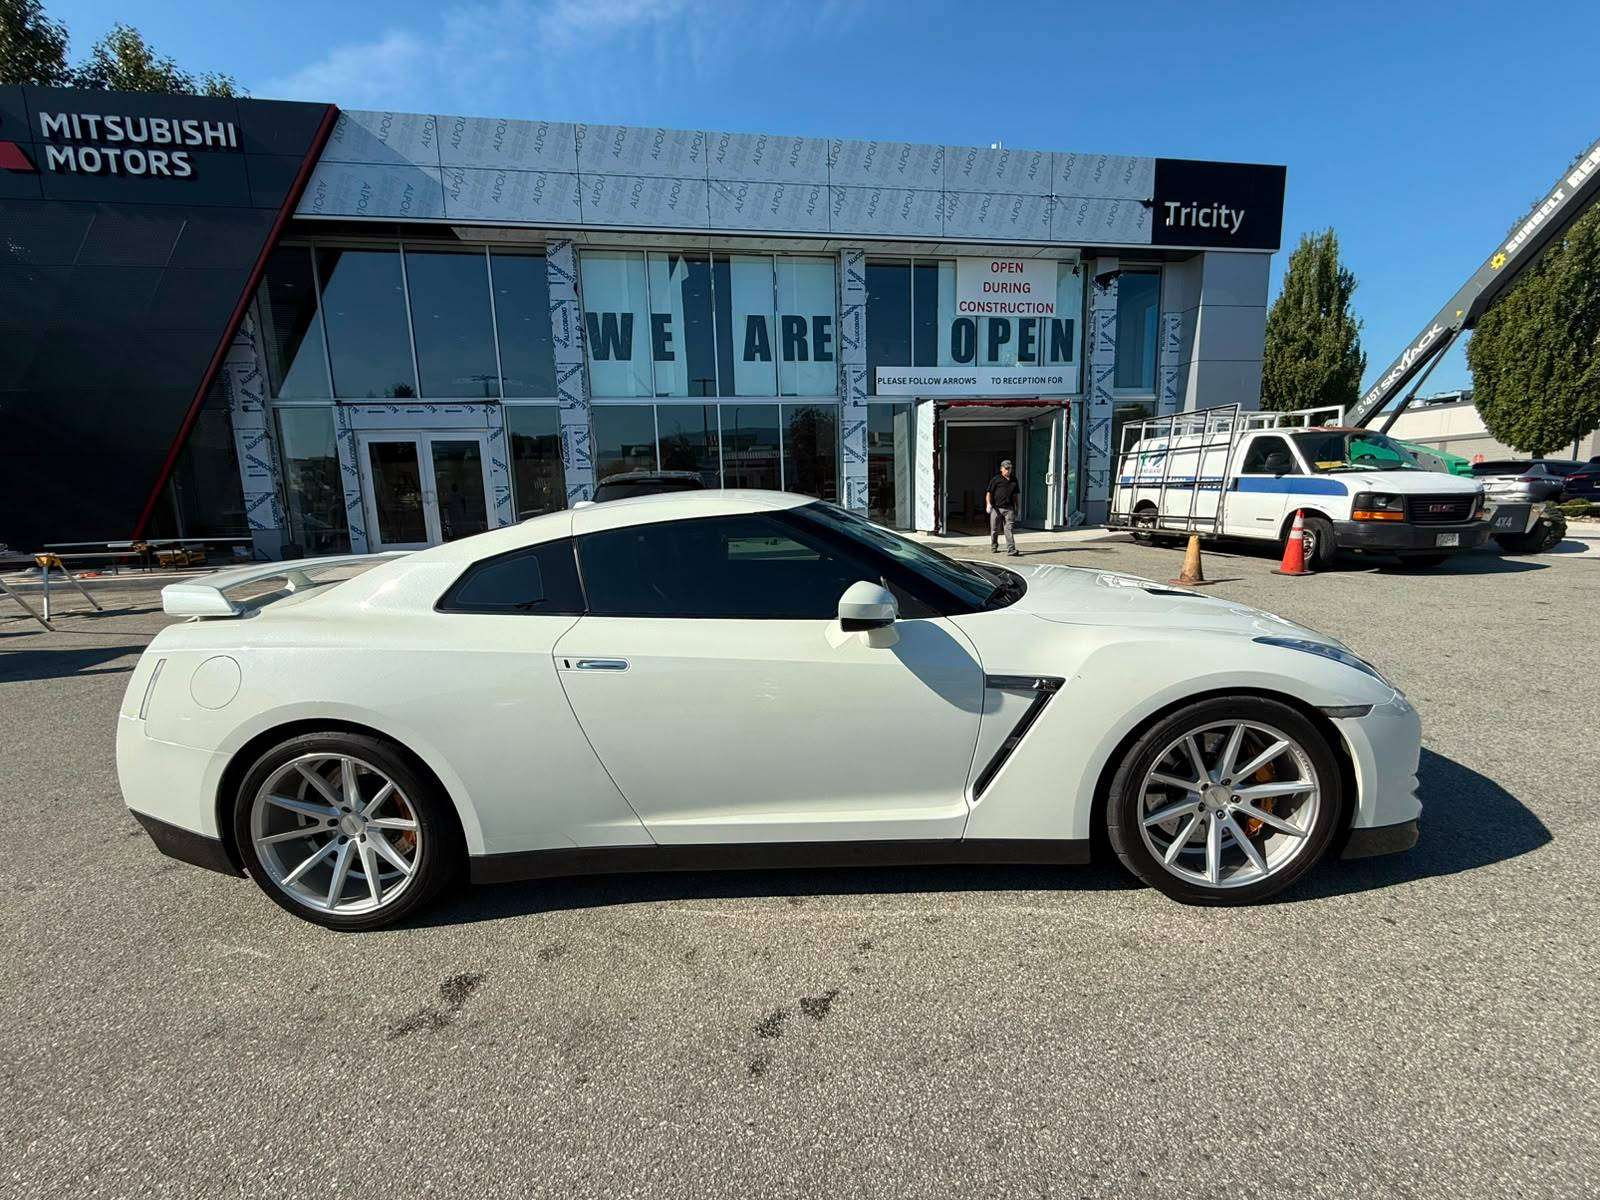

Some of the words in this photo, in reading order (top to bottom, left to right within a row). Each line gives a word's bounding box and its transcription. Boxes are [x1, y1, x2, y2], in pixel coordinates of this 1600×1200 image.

[39, 112, 237, 148] MITSUBISHI
[45, 144, 192, 177] MOTORS
[1164, 201, 1245, 234] Tricity
[1505, 187, 1565, 253] SUNBELT
[991, 261, 1024, 274] OPEN
[983, 281, 1031, 294] DURING
[959, 300, 1054, 314] CONSTRUCTION
[585, 312, 675, 361] WE
[743, 314, 834, 362] ARE
[950, 317, 1075, 364] OPEN
[1381, 323, 1444, 391] SKYJACK
[877, 376, 907, 386] PLEASE
[908, 376, 940, 386] FOLLOW
[942, 376, 977, 386] ARROWS
[991, 376, 1001, 385] TO
[1003, 376, 1046, 385] RECEPTION
[1047, 376, 1063, 385] FOR
[1495, 516, 1513, 528] 4X4
